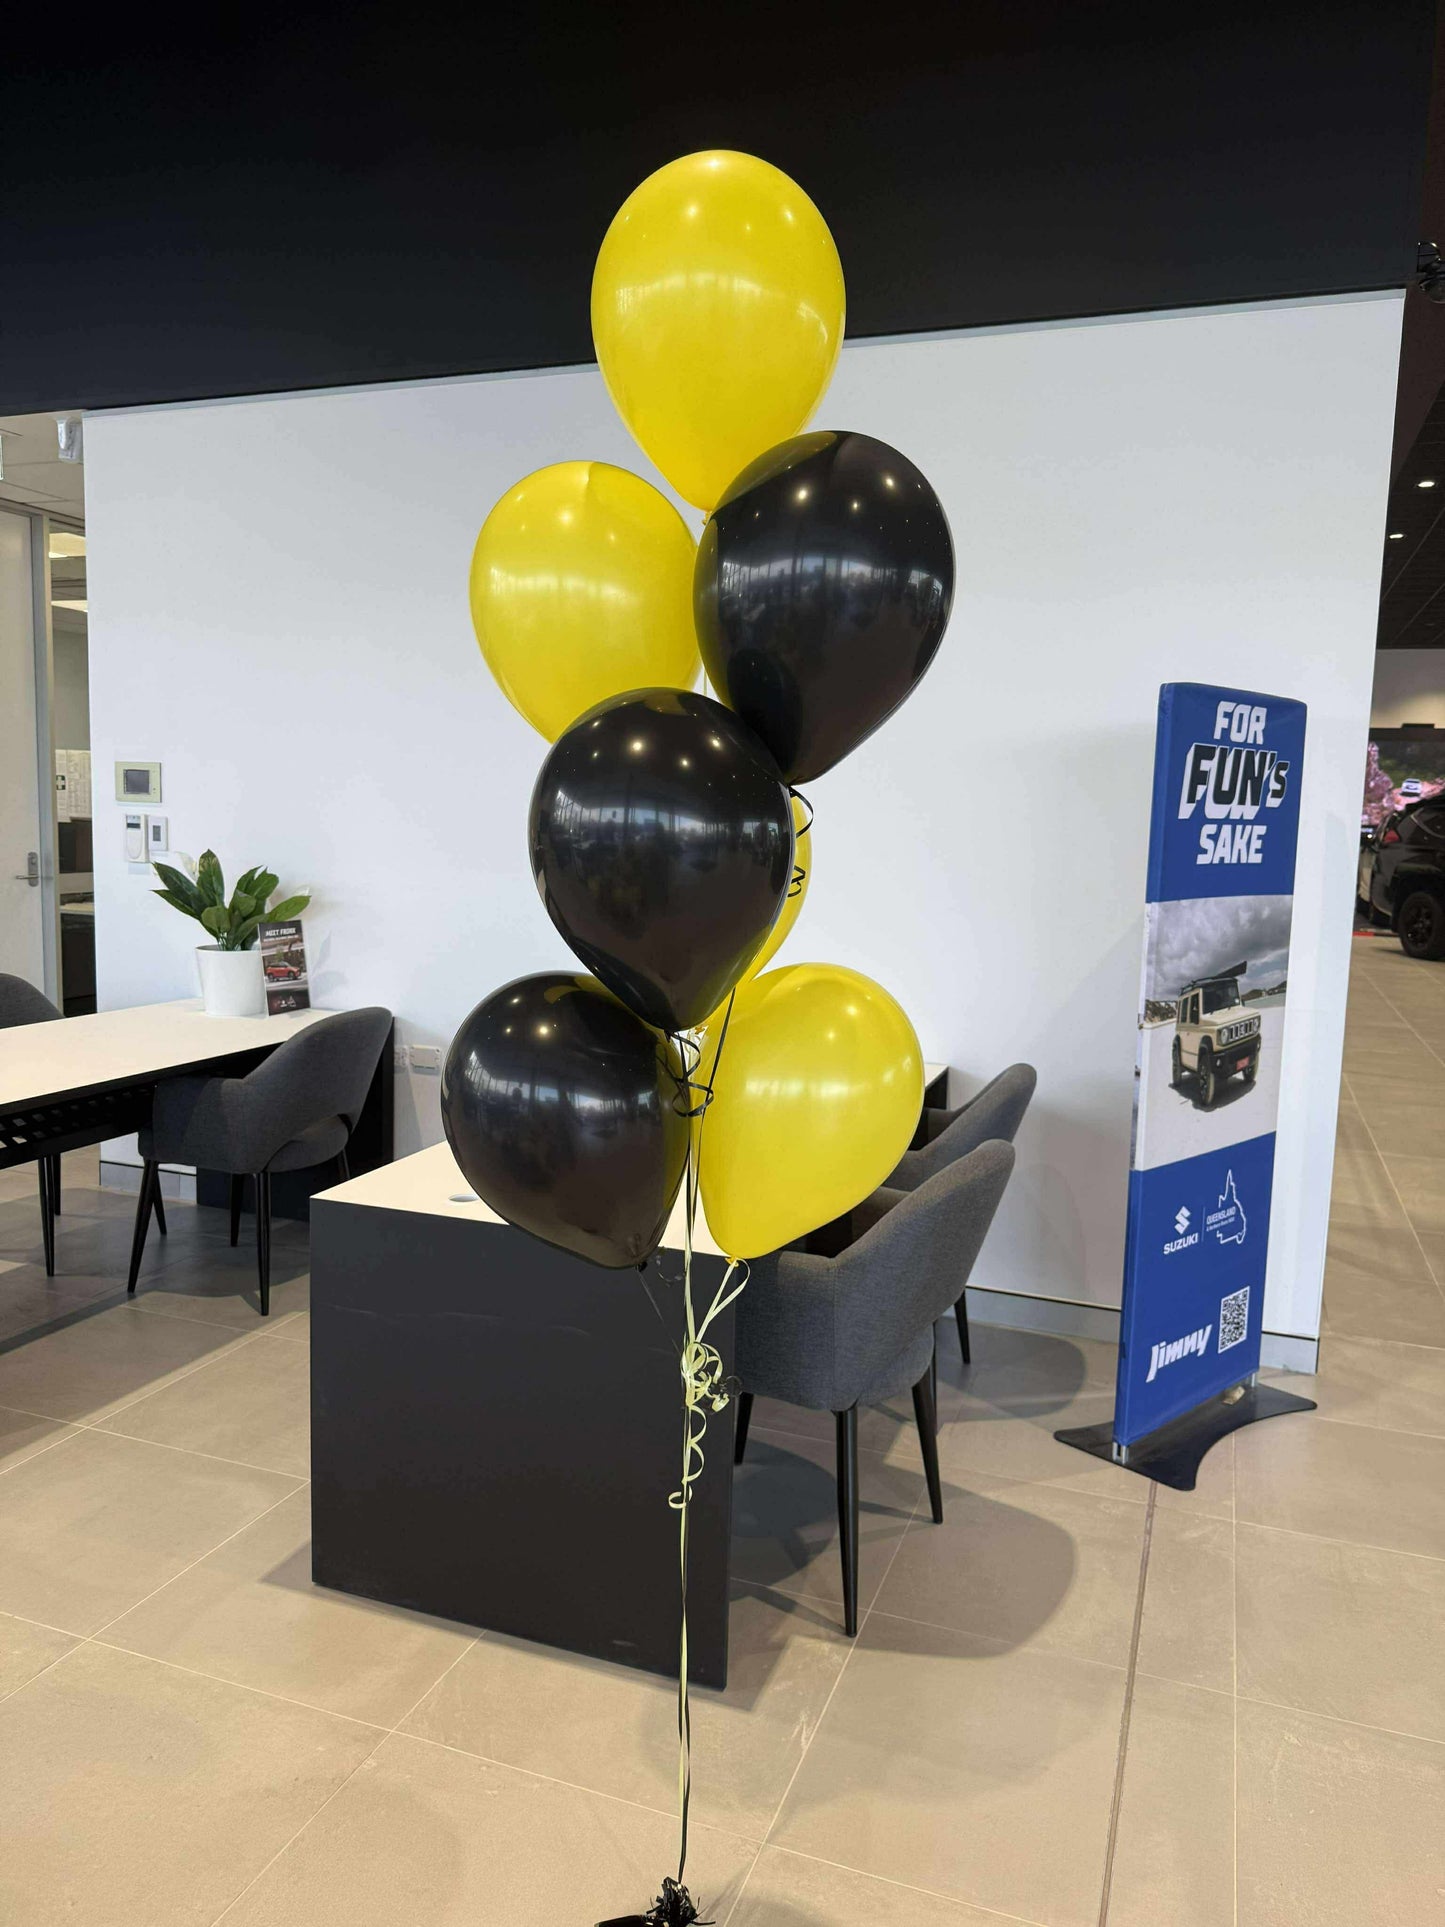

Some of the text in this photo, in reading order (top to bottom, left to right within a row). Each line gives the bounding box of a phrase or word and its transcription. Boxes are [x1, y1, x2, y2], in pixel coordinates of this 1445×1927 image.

[1213, 701, 1267, 745] FOR
[1197, 824, 1267, 864] SAKE
[1206, 1206, 1236, 1225] QUEENSLAND
[1163, 1232, 1199, 1255] SUZUKI
[1146, 1324, 1212, 1383] Jimny
